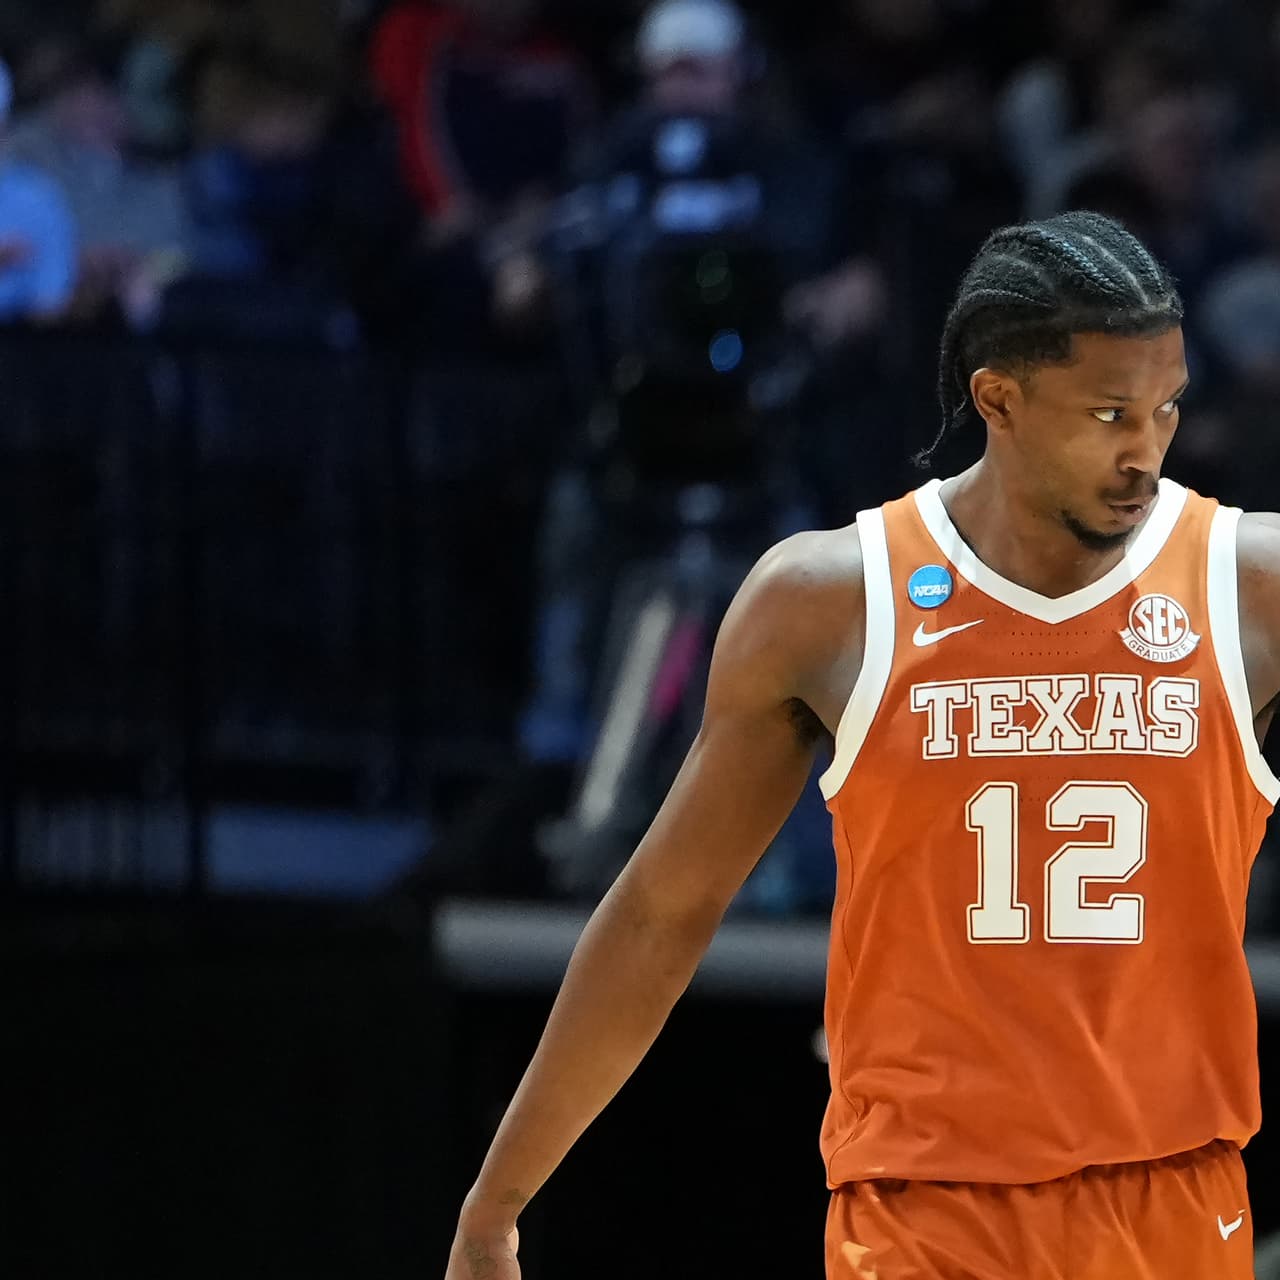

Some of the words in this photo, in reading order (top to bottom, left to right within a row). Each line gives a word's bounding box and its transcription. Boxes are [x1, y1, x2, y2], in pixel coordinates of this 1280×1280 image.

[1128, 639, 1190, 661] GRADUATE
[1135, 597, 1186, 645] SEC
[910, 674, 1200, 760] TEXAS
[965, 780, 1148, 945] 12
